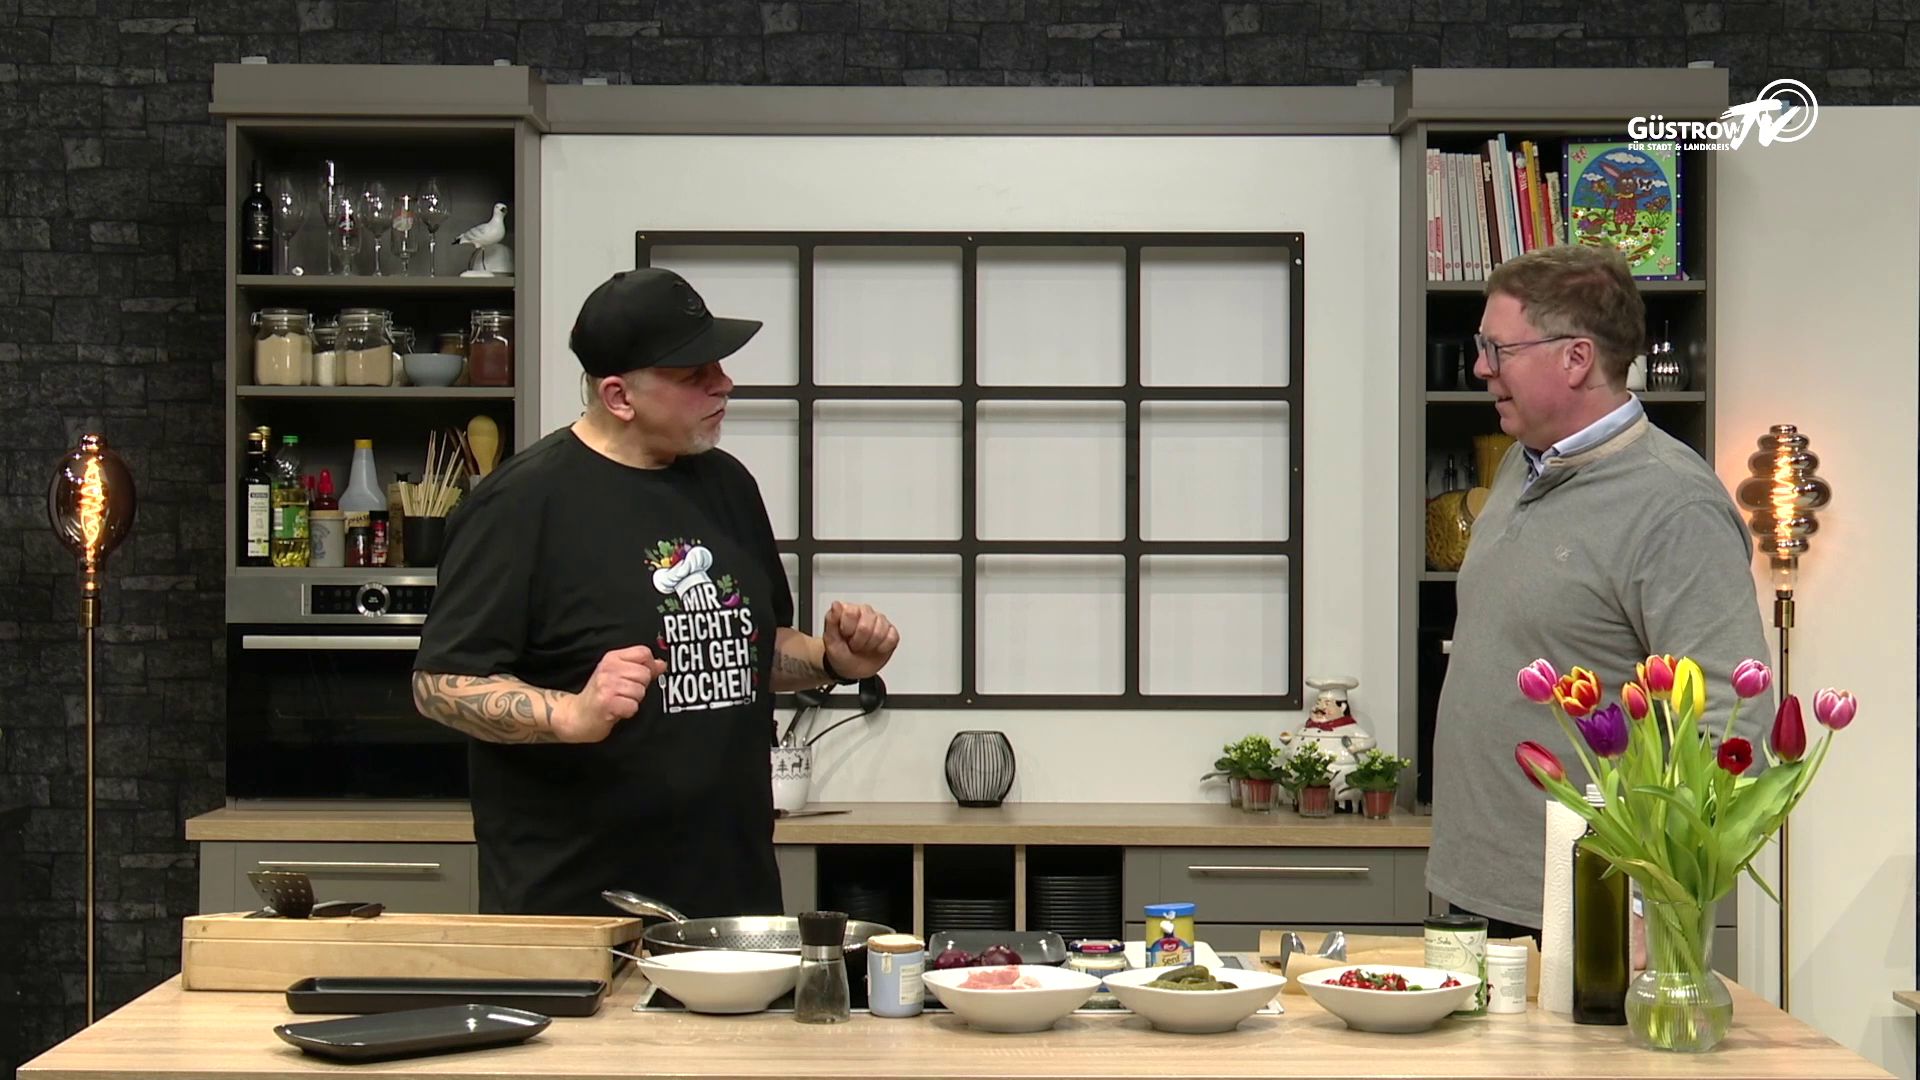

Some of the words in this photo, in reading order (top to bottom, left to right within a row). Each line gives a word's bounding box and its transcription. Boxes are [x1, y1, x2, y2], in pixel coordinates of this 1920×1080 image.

[682, 583, 721, 611] MIR
[663, 608, 752, 643] REICHT'S
[670, 642, 704, 673] ICH
[709, 638, 749, 669] GEH
[668, 667, 752, 705] KOCHEN
